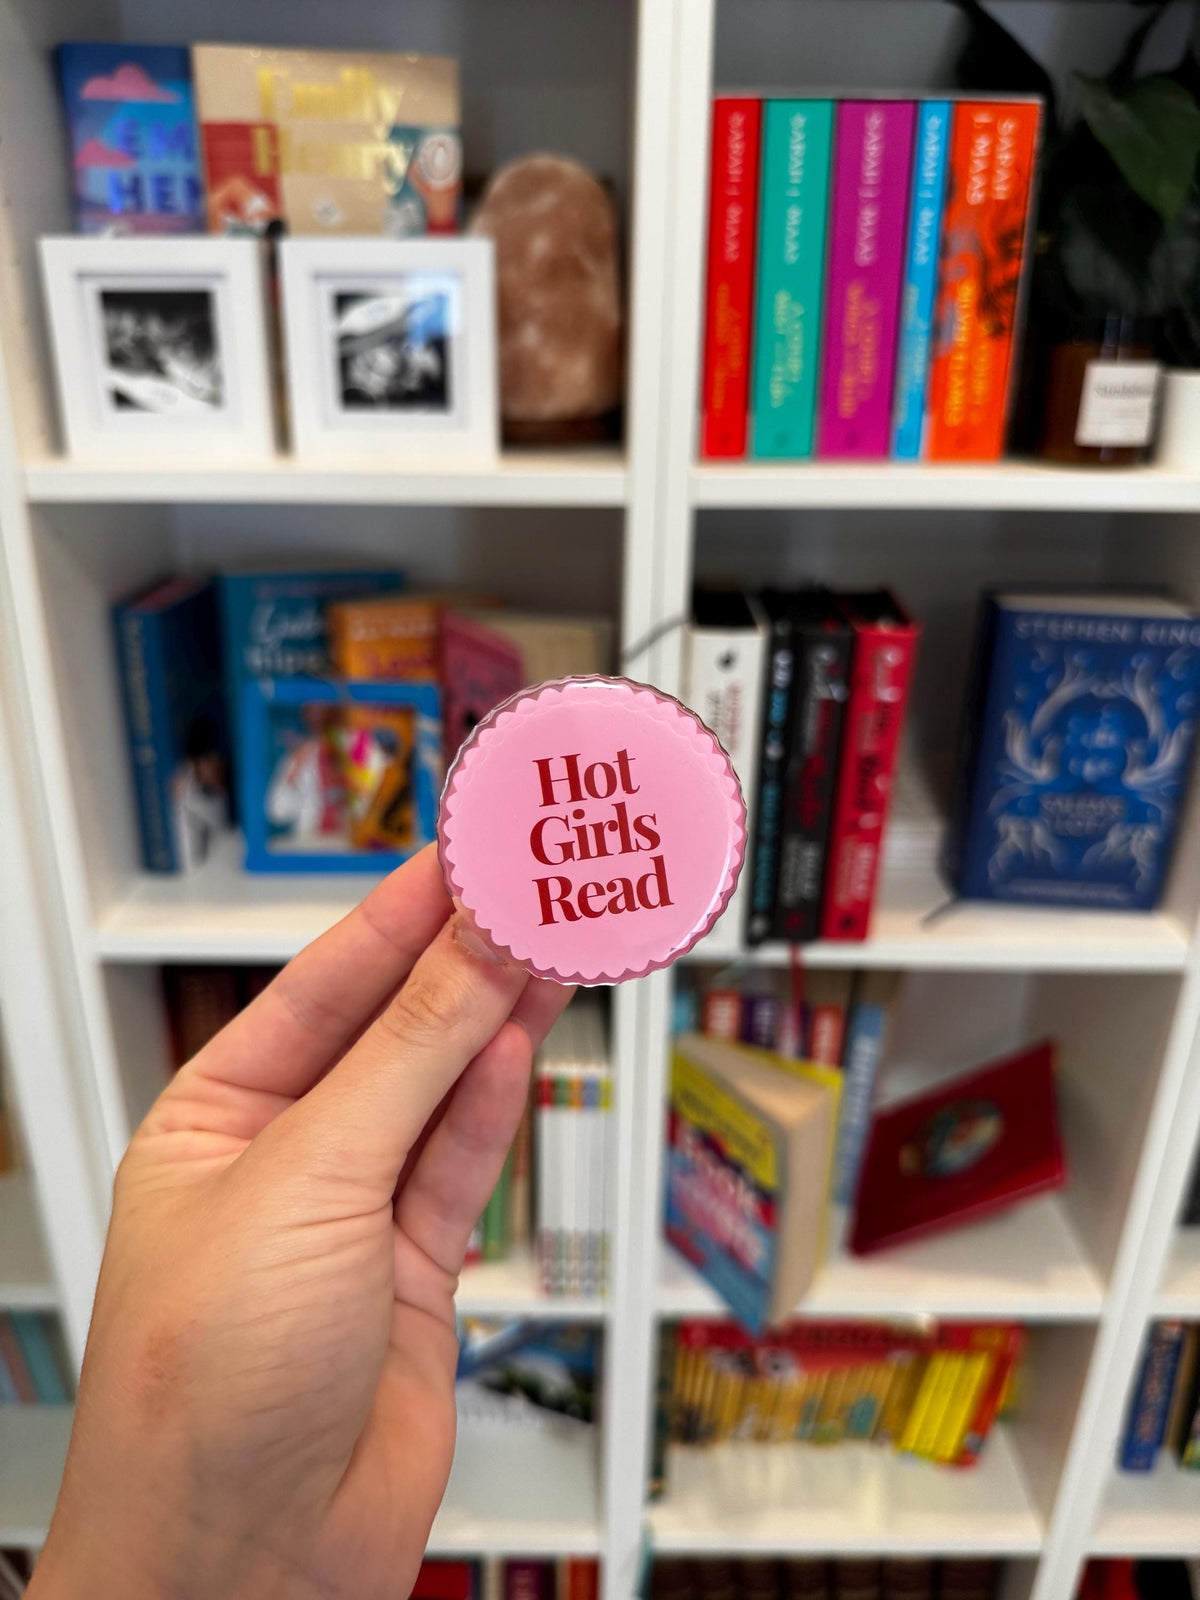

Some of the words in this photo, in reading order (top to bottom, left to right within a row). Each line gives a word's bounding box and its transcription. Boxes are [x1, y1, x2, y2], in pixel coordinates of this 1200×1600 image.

[966, 134, 991, 206] MAAS
[1015, 615, 1135, 644] STEPHEN
[532, 748, 641, 808] Hot
[529, 801, 661, 866] Girls
[531, 854, 675, 926] Read
